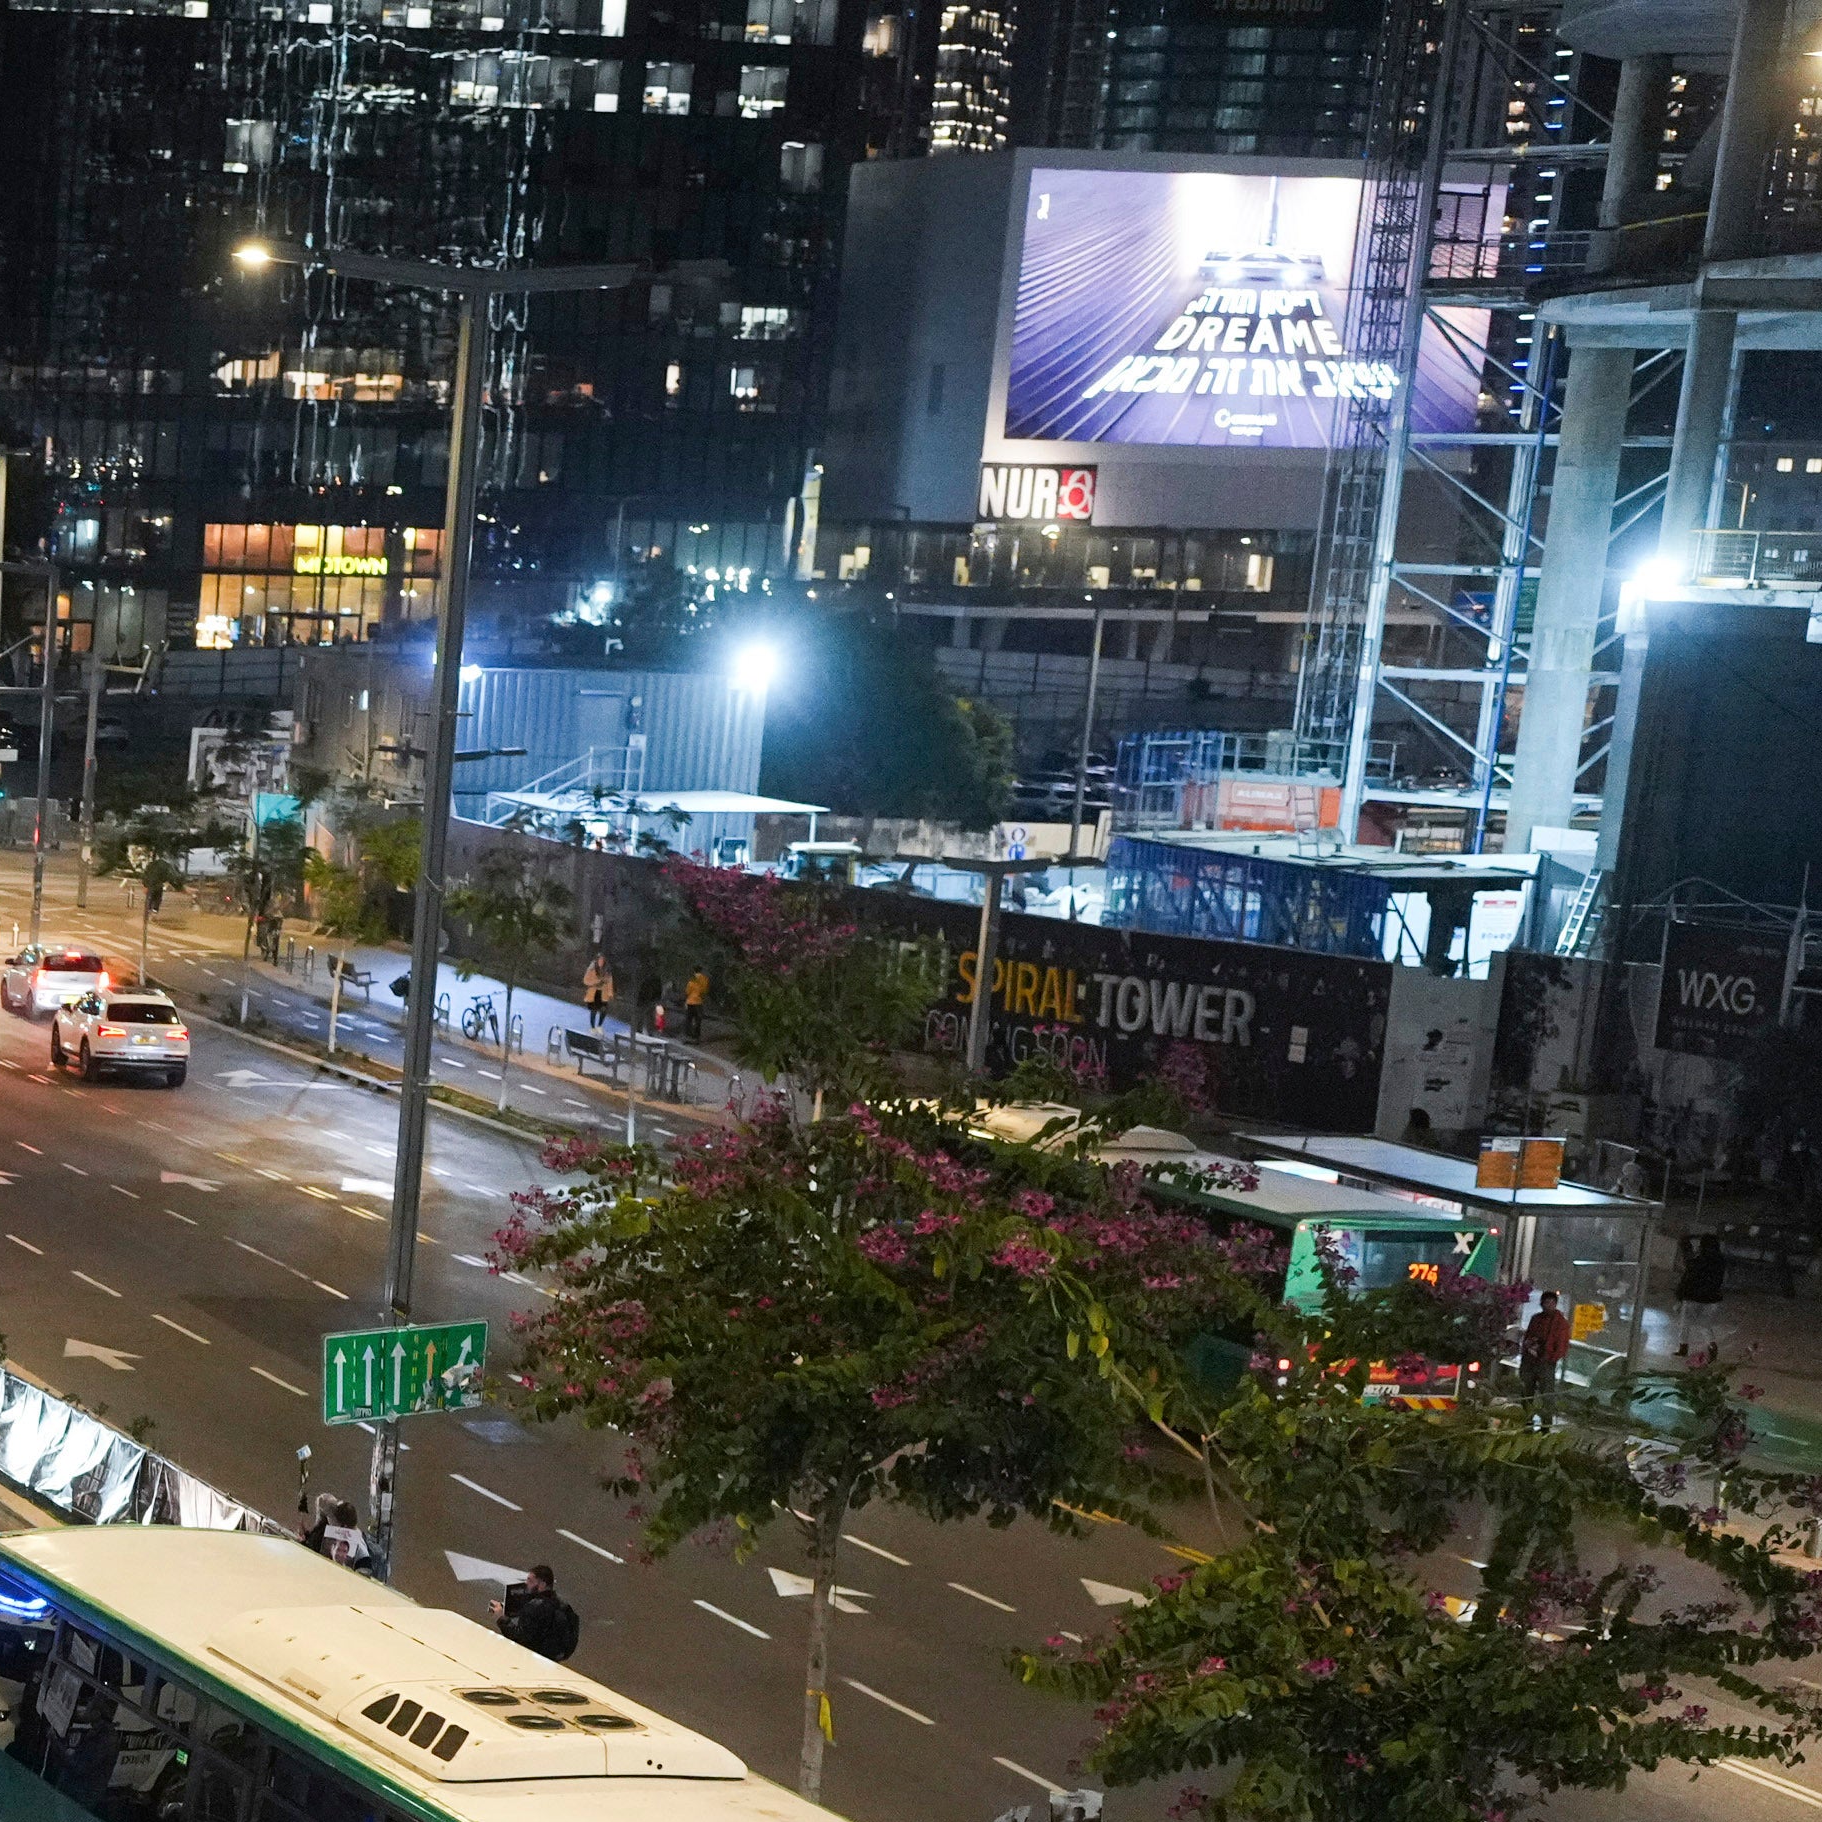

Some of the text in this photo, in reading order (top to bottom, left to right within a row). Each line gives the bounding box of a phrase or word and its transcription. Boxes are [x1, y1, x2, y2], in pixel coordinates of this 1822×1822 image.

[1154, 317, 1342, 354] DREAME
[979, 467, 1060, 519] NUR
[297, 556, 387, 575] MIDTOWN
[957, 951, 1082, 1025] SPIRAL
[1092, 973, 1256, 1047] TOWER
[1678, 967, 1756, 1016] WXG
